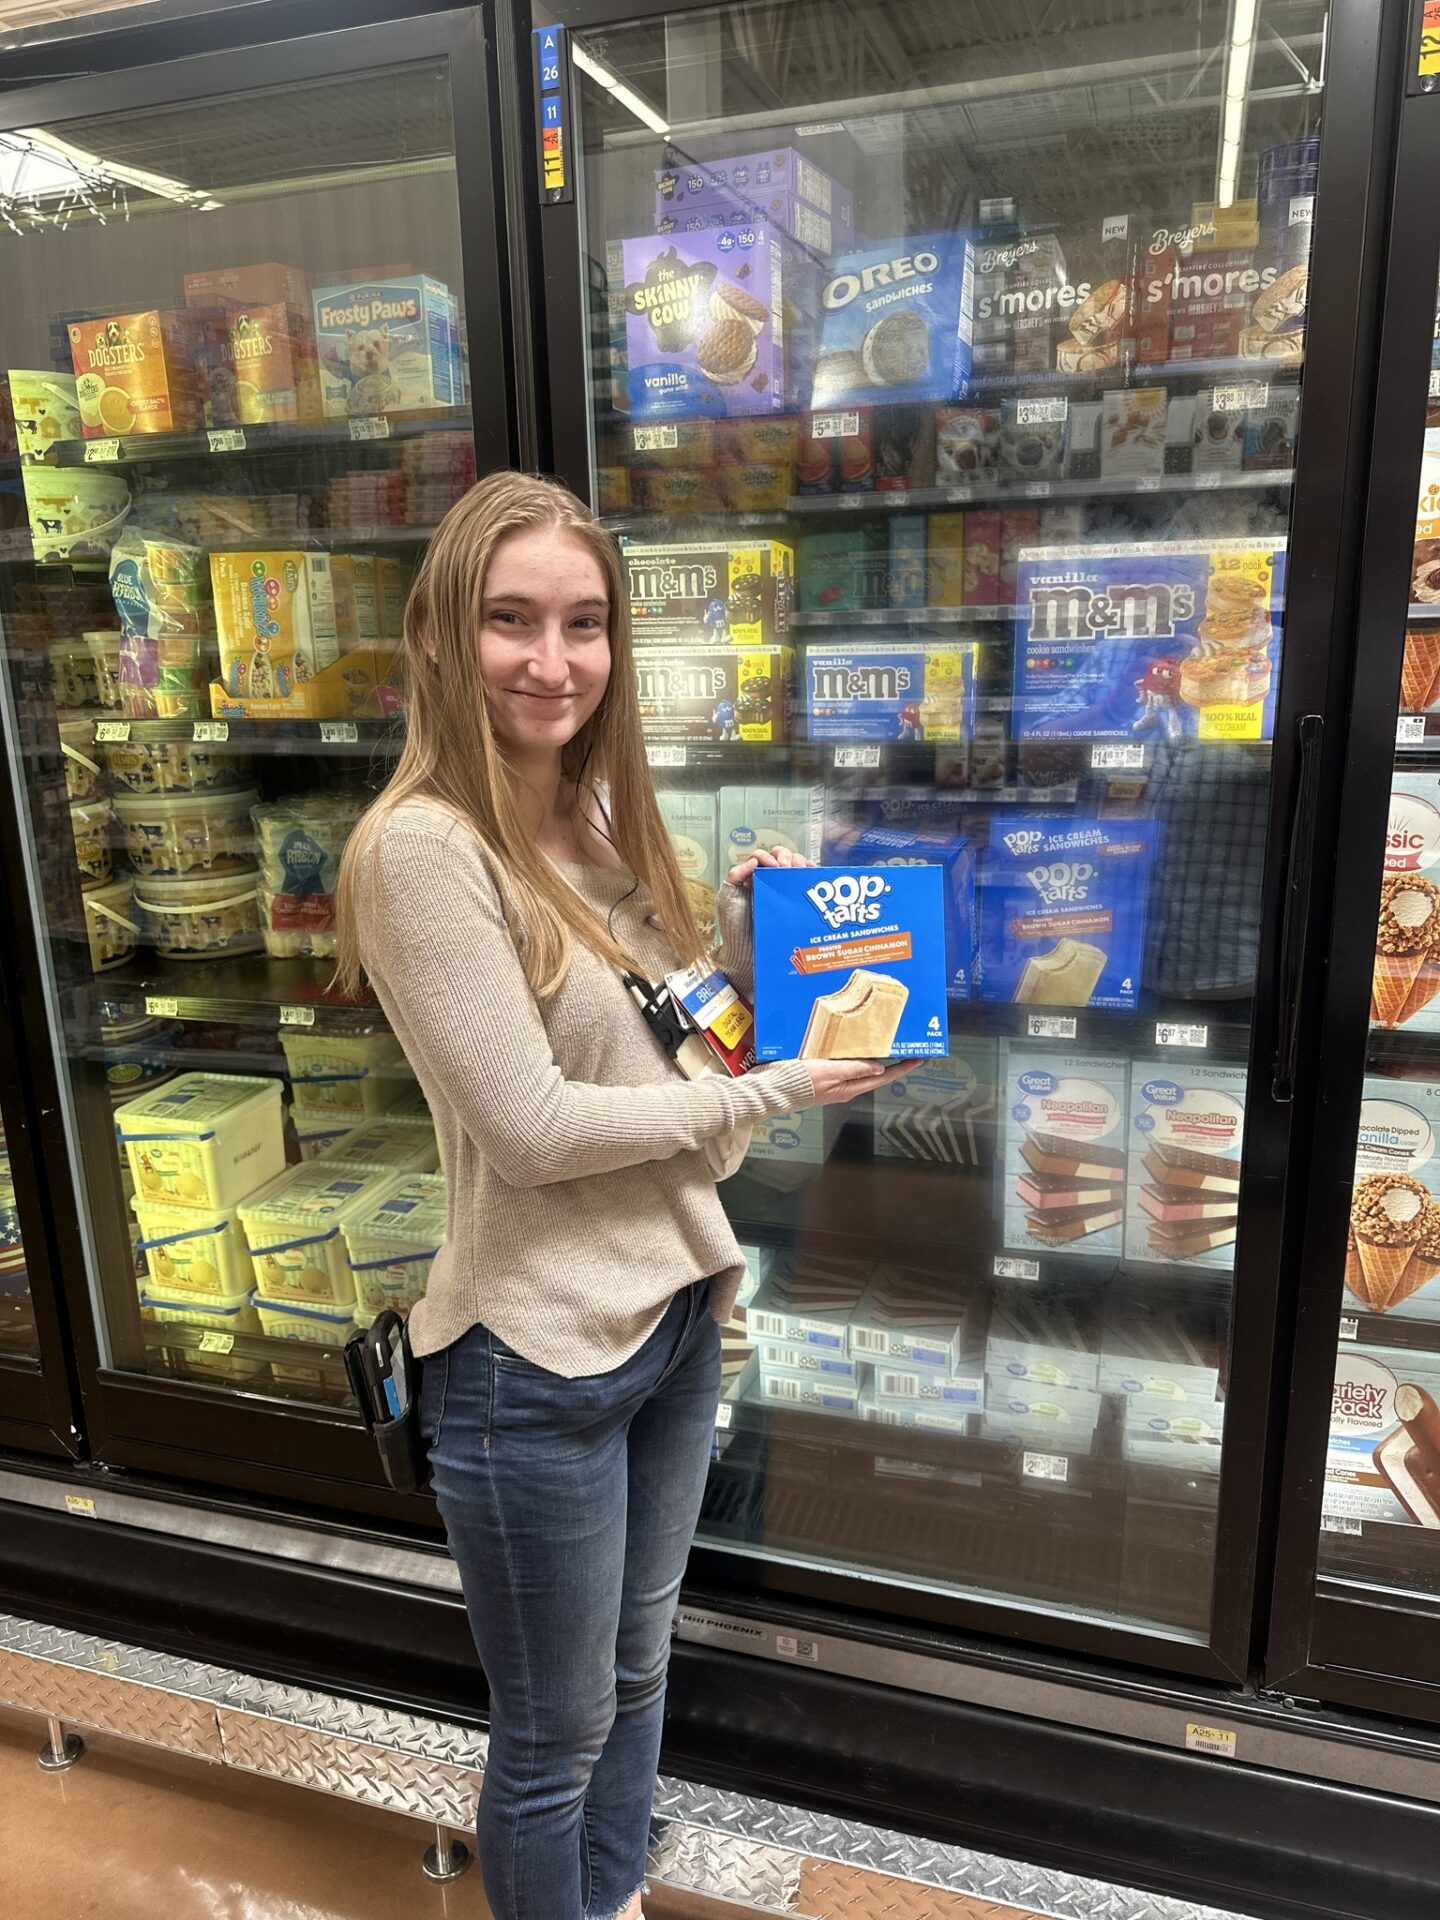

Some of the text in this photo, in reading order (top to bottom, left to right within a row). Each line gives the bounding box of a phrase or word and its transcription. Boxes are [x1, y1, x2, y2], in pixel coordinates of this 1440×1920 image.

[544, 35, 554, 48] A
[1420, 35, 1440, 60] 12
[543, 66, 559, 81] 26
[547, 105, 557, 119] 11
[551, 132, 559, 144] 26
[544, 156, 560, 176] 11
[688, 178, 703, 190] 150
[1105, 226, 1125, 236] NEW
[1149, 221, 1218, 255] Breyers
[739, 233, 755, 244] 150
[980, 240, 1039, 273] Breyers
[657, 269, 674, 282] the
[1175, 263, 1206, 274] AMPFIRE
[822, 252, 939, 310] OREO
[1001, 281, 1029, 291] AMPFIRE
[1147, 266, 1278, 303] s'mores
[634, 274, 701, 311] SKINNY
[978, 282, 1092, 319] s'mores
[321, 298, 417, 328] Frosty Paws
[651, 301, 690, 327] COW
[1188, 303, 1224, 316] HERSHEY'S
[88, 343, 145, 369] DOGSTERS
[221, 336, 272, 362] DOGSTERS
[645, 373, 687, 387] vanilla
[628, 557, 676, 566] chocolate
[1218, 558, 1262, 572] 12 pack
[285, 560, 298, 592] KEMPS
[629, 565, 717, 600] m&m's
[1030, 572, 1098, 584] vanilla
[241, 582, 249, 610] Banana
[1027, 584, 1195, 642] m&m's
[1026, 643, 1095, 655] cookie sandwiches
[636, 659, 686, 667] chocolate
[637, 666, 727, 699] m&m's
[813, 666, 911, 701] m&m's
[1206, 712, 1257, 722] 100% REAL
[676, 815, 713, 823] SANDWICHES
[767, 809, 805, 817] SANDWICHES
[731, 830, 752, 840] Great
[1049, 829, 1102, 844] ICE CREAM
[1043, 835, 1110, 852] SANDWICHES
[1039, 885, 1088, 904] tarts
[824, 902, 881, 929] tarts
[1037, 907, 1059, 915] CREAM
[1060, 904, 1103, 914] SANDWICHES
[1022, 916, 1109, 930] BROWN SUGAR CINNAMON
[809, 924, 899, 945] ICE CREAM SANDWICHES
[805, 951, 835, 962] BROWN
[837, 947, 863, 958] SUGAR
[863, 940, 908, 953] CINNAMON
[956, 969, 965, 980] 4
[1122, 978, 1132, 989] 4
[722, 1010, 739, 1029] DIGITAL
[725, 1012, 746, 1039] TEAM LEAD
[928, 1016, 940, 1031] 4
[1064, 1059, 1073, 1067] 12
[1190, 1068, 1201, 1077] 12
[1022, 1074, 1052, 1087] Great
[1146, 1084, 1177, 1096] Great
[1153, 1093, 1176, 1101] Value
[1426, 1088, 1432, 1096] 8
[1041, 1098, 1108, 1115] Neapolitan
[1165, 1109, 1237, 1126] Neapolitan
[1359, 1125, 1420, 1136] ocolate Dipped
[1365, 1145, 1388, 1153] Cream
[1331, 1397, 1383, 1419] Pack
[1347, 1418, 1383, 1428] Flavored
[1335, 1469, 1357, 1478] Cones
[1219, 1733, 1229, 1741] 11
